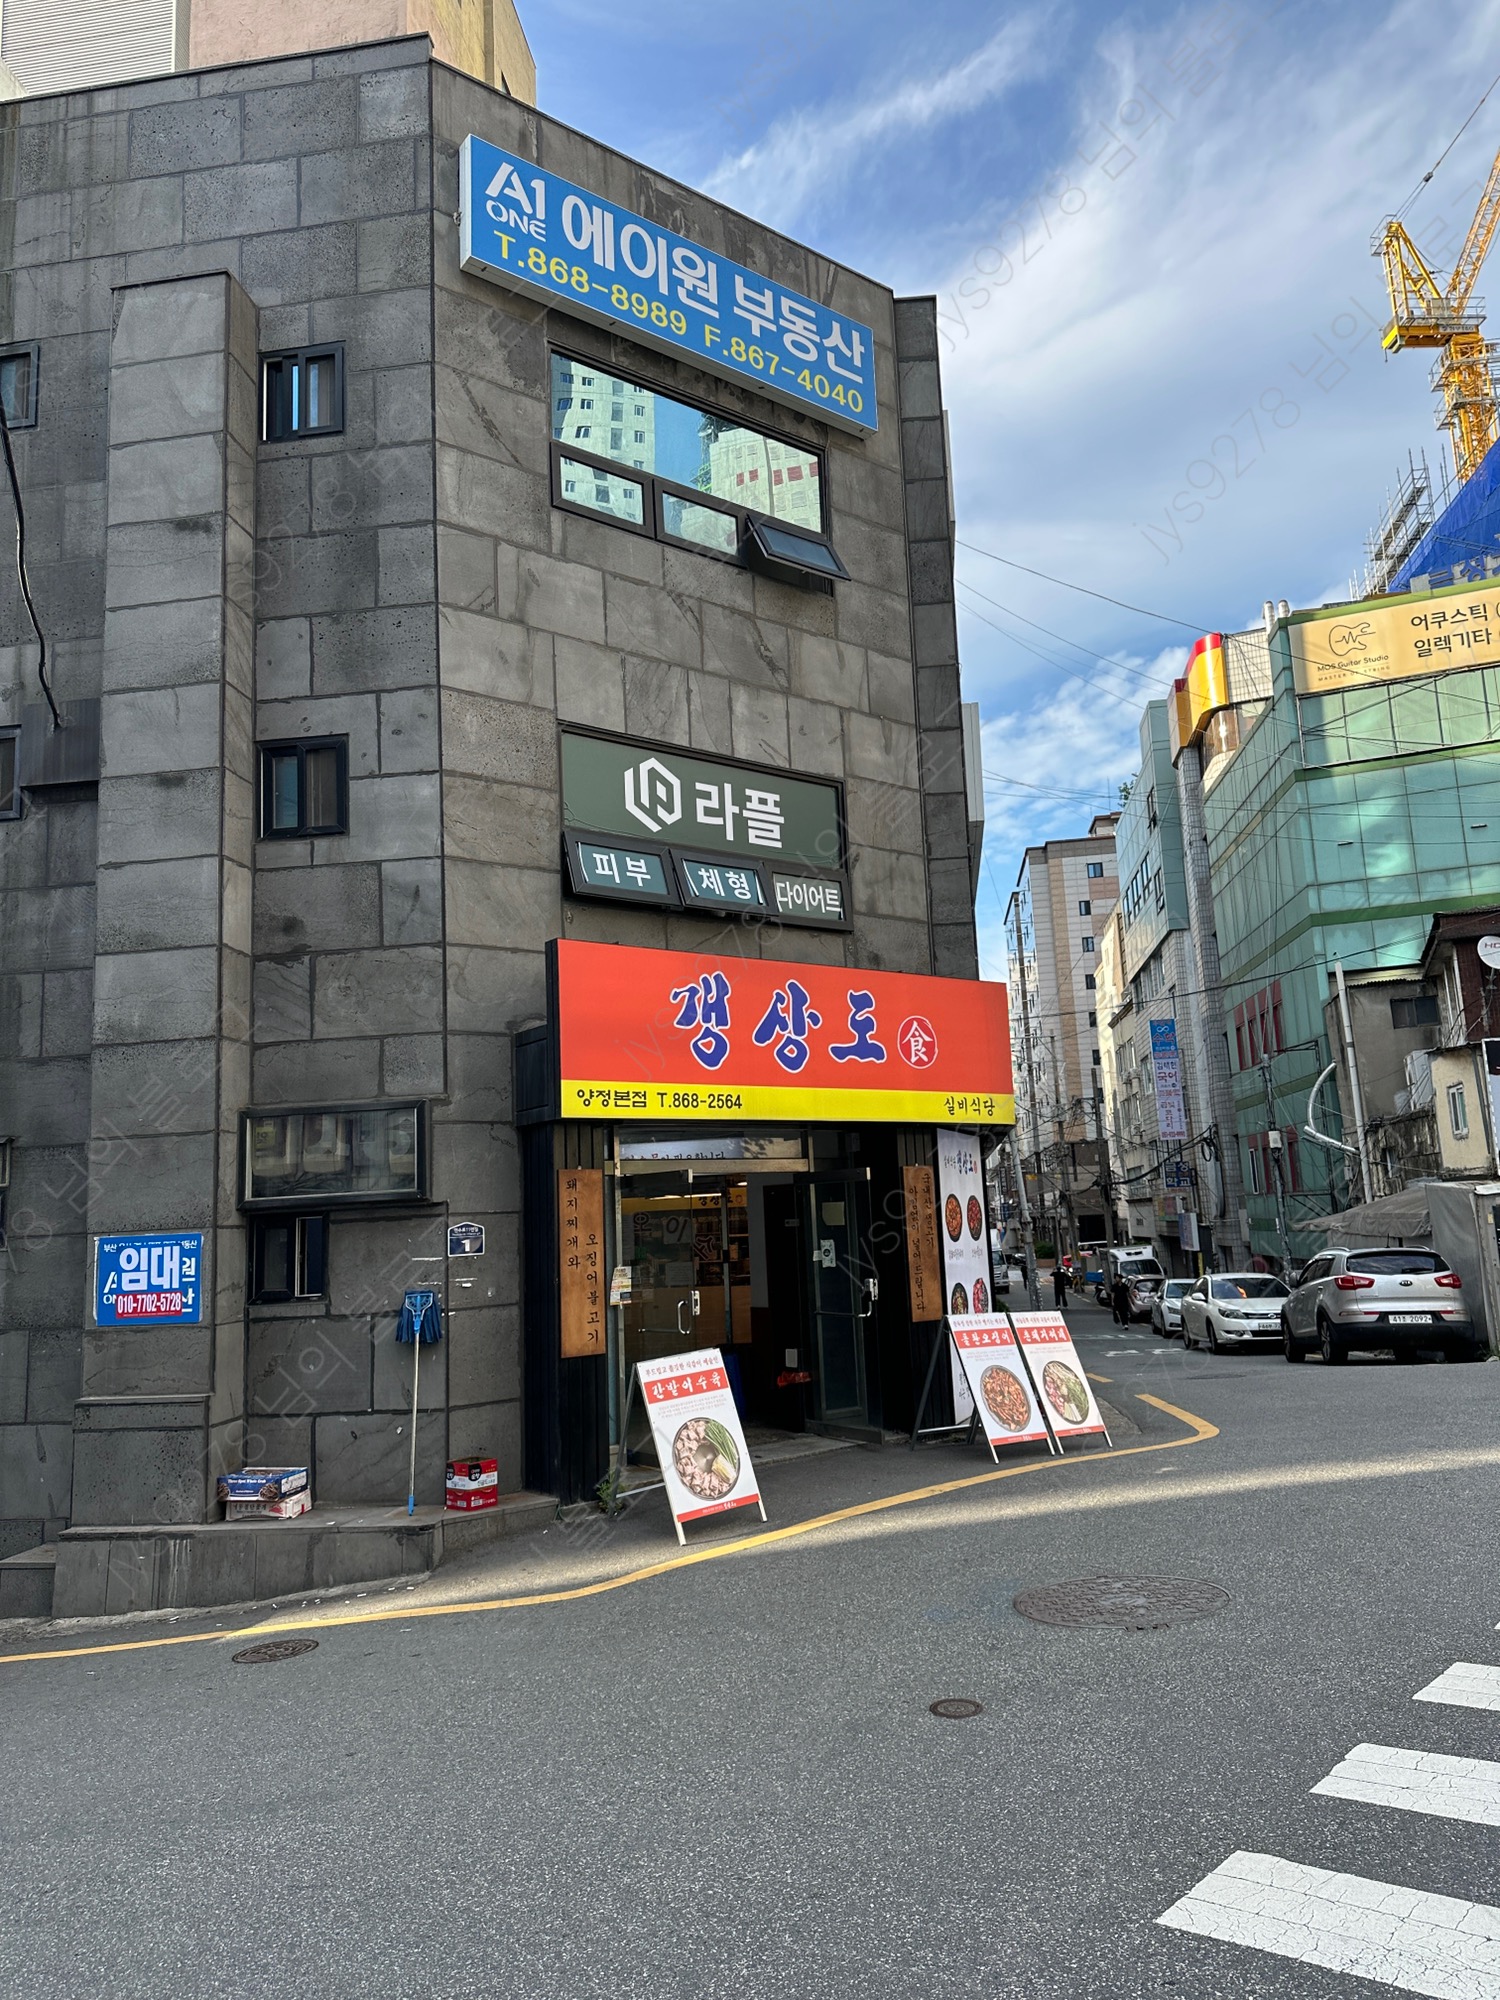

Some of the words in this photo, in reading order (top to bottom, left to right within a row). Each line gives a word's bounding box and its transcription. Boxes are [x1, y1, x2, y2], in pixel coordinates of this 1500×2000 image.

[484, 161, 547, 220] A1
[486, 198, 547, 242] ONE
[561, 194, 720, 319] 에이원
[733, 274, 865, 385] 부동산
[493, 229, 688, 337] T.868-8989
[703, 323, 864, 415] F.867-4040
[1411, 603, 1488, 631] 어쿠스틱
[1414, 628, 1493, 658] 일렉기타
[1317, 664, 1337, 672] MOS
[1337, 658, 1362, 669] Guitar
[1364, 655, 1389, 664] Studio
[1318, 673, 1347, 681] MASTER
[694, 779, 786, 849] 라플
[592, 851, 652, 888] 피부
[700, 866, 752, 900] 체형
[776, 882, 843, 914] 다이어트
[670, 970, 887, 1074] 갱상도
[901, 1019, 933, 1065] 食
[576, 1088, 648, 1110] 양정본점
[657, 1091, 743, 1110] T.868-2564
[943, 1095, 996, 1117] 실비식당
[566, 1178, 581, 1269] 돼지찌개와
[460, 1239, 470, 1252] 1
[119, 1246, 180, 1292] 임대
[117, 1292, 181, 1314] 010-7702-5728
[586, 1233, 600, 1343] 오징어불고기
